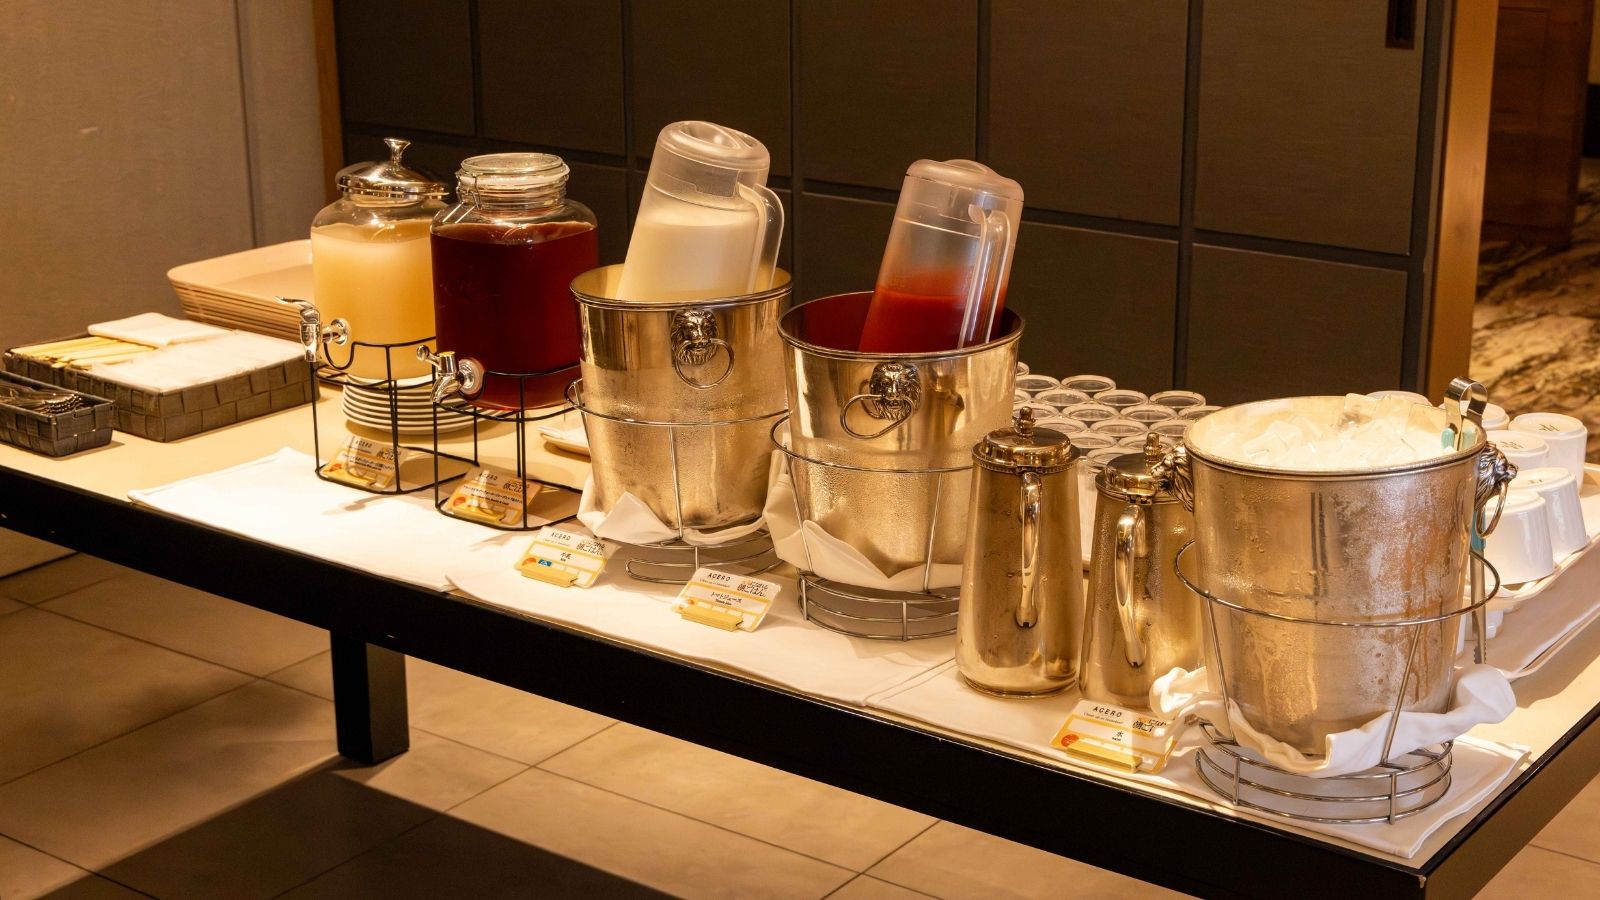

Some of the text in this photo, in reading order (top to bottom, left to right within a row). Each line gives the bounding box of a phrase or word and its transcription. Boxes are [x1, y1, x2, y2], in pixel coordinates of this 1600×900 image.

[550, 531, 572, 541] ACERO
[708, 572, 731, 582] ACERO
[1092, 706, 1122, 718] ACERO
[1116, 730, 1124, 738] 水
